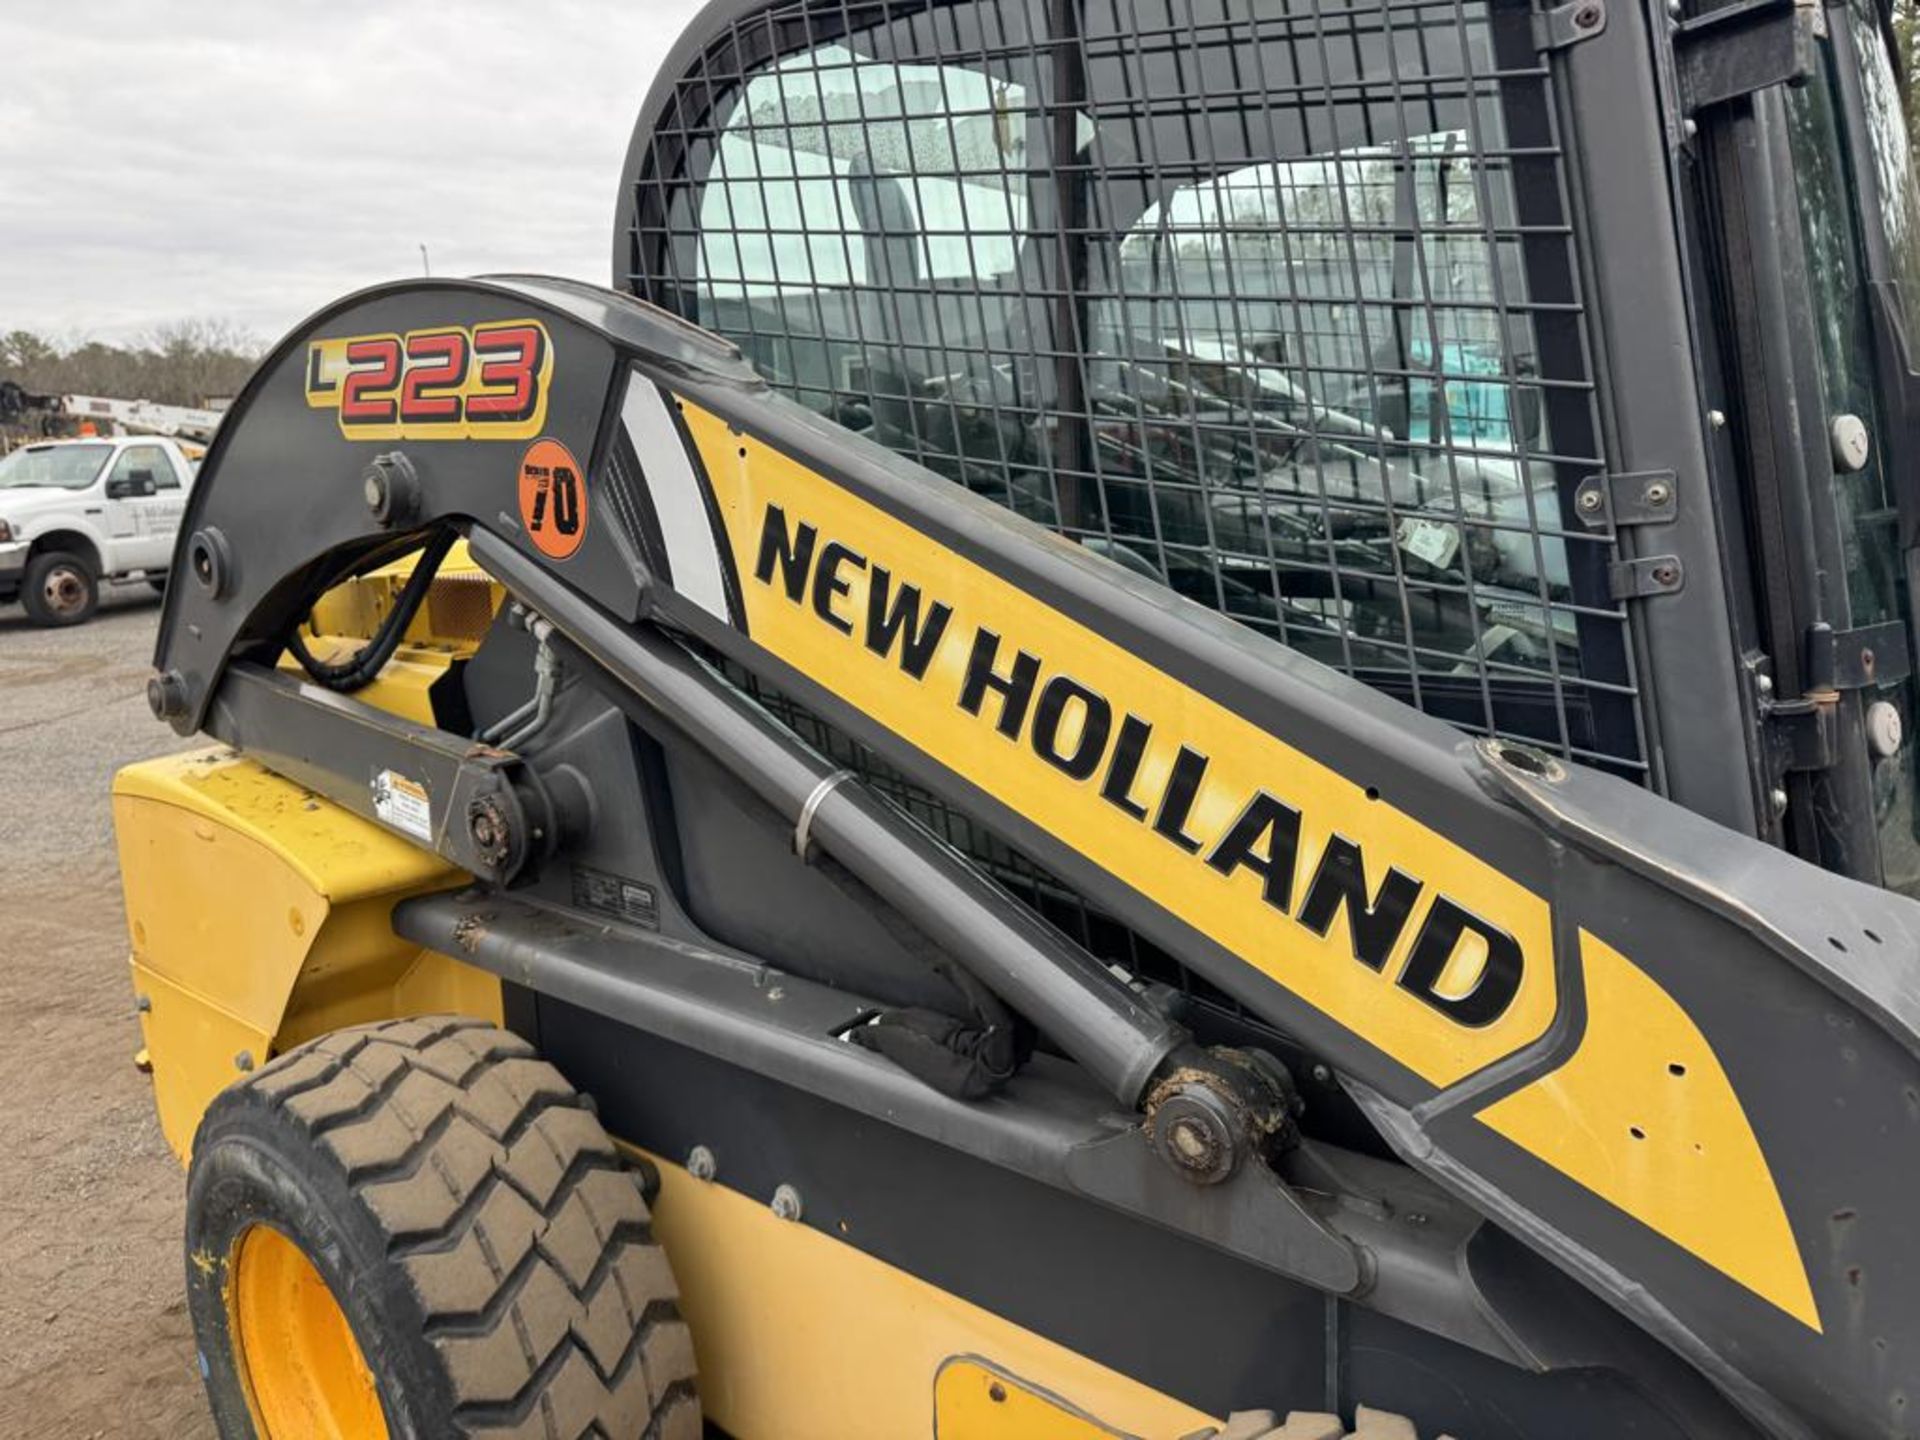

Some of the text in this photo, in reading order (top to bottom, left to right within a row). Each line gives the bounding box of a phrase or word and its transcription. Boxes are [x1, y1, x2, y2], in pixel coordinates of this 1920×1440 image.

[309, 324, 546, 424] L223
[754, 502, 1526, 1029] NEW HOLLAND
